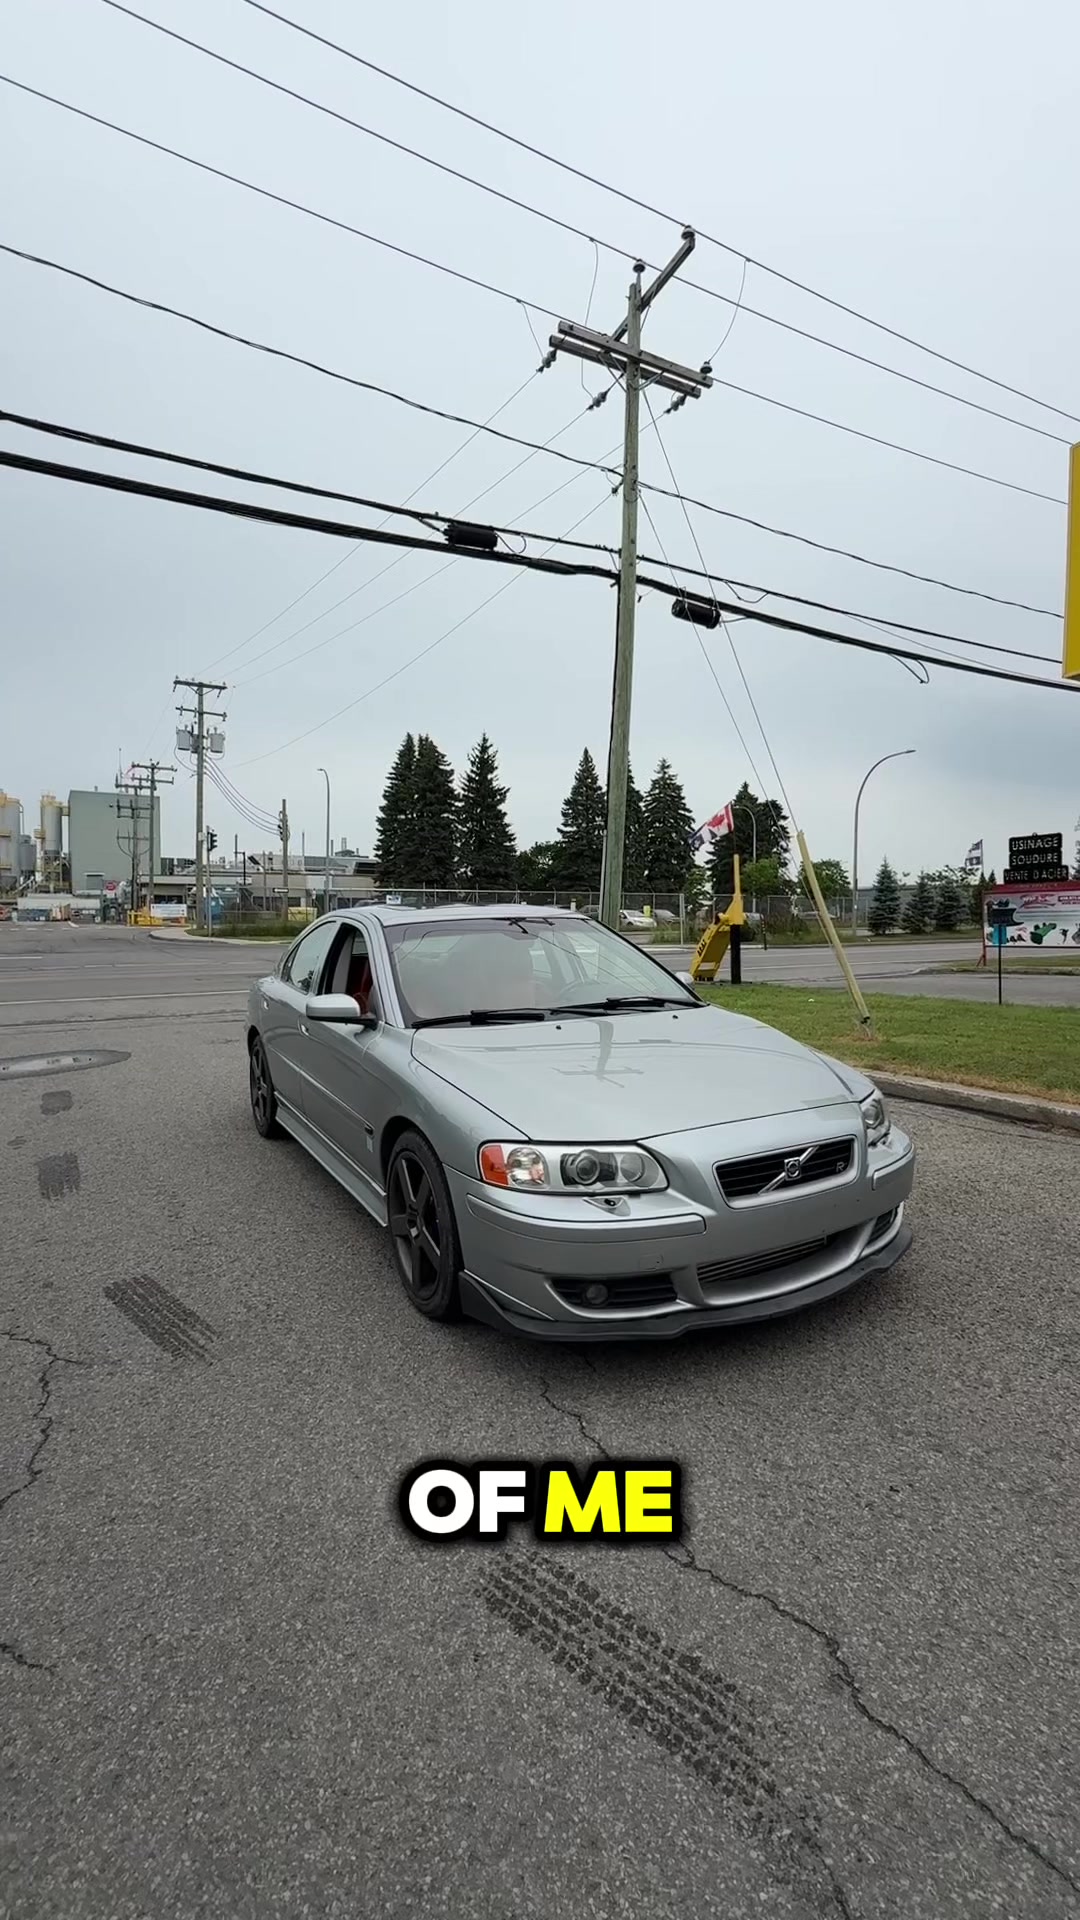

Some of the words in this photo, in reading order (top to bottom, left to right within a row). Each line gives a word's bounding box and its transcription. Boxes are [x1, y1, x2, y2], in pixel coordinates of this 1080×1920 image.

[1012, 837, 1058, 850] USINAGE
[1011, 853, 1058, 865] SOUDURE
[1005, 870, 1028, 880] VENTE
